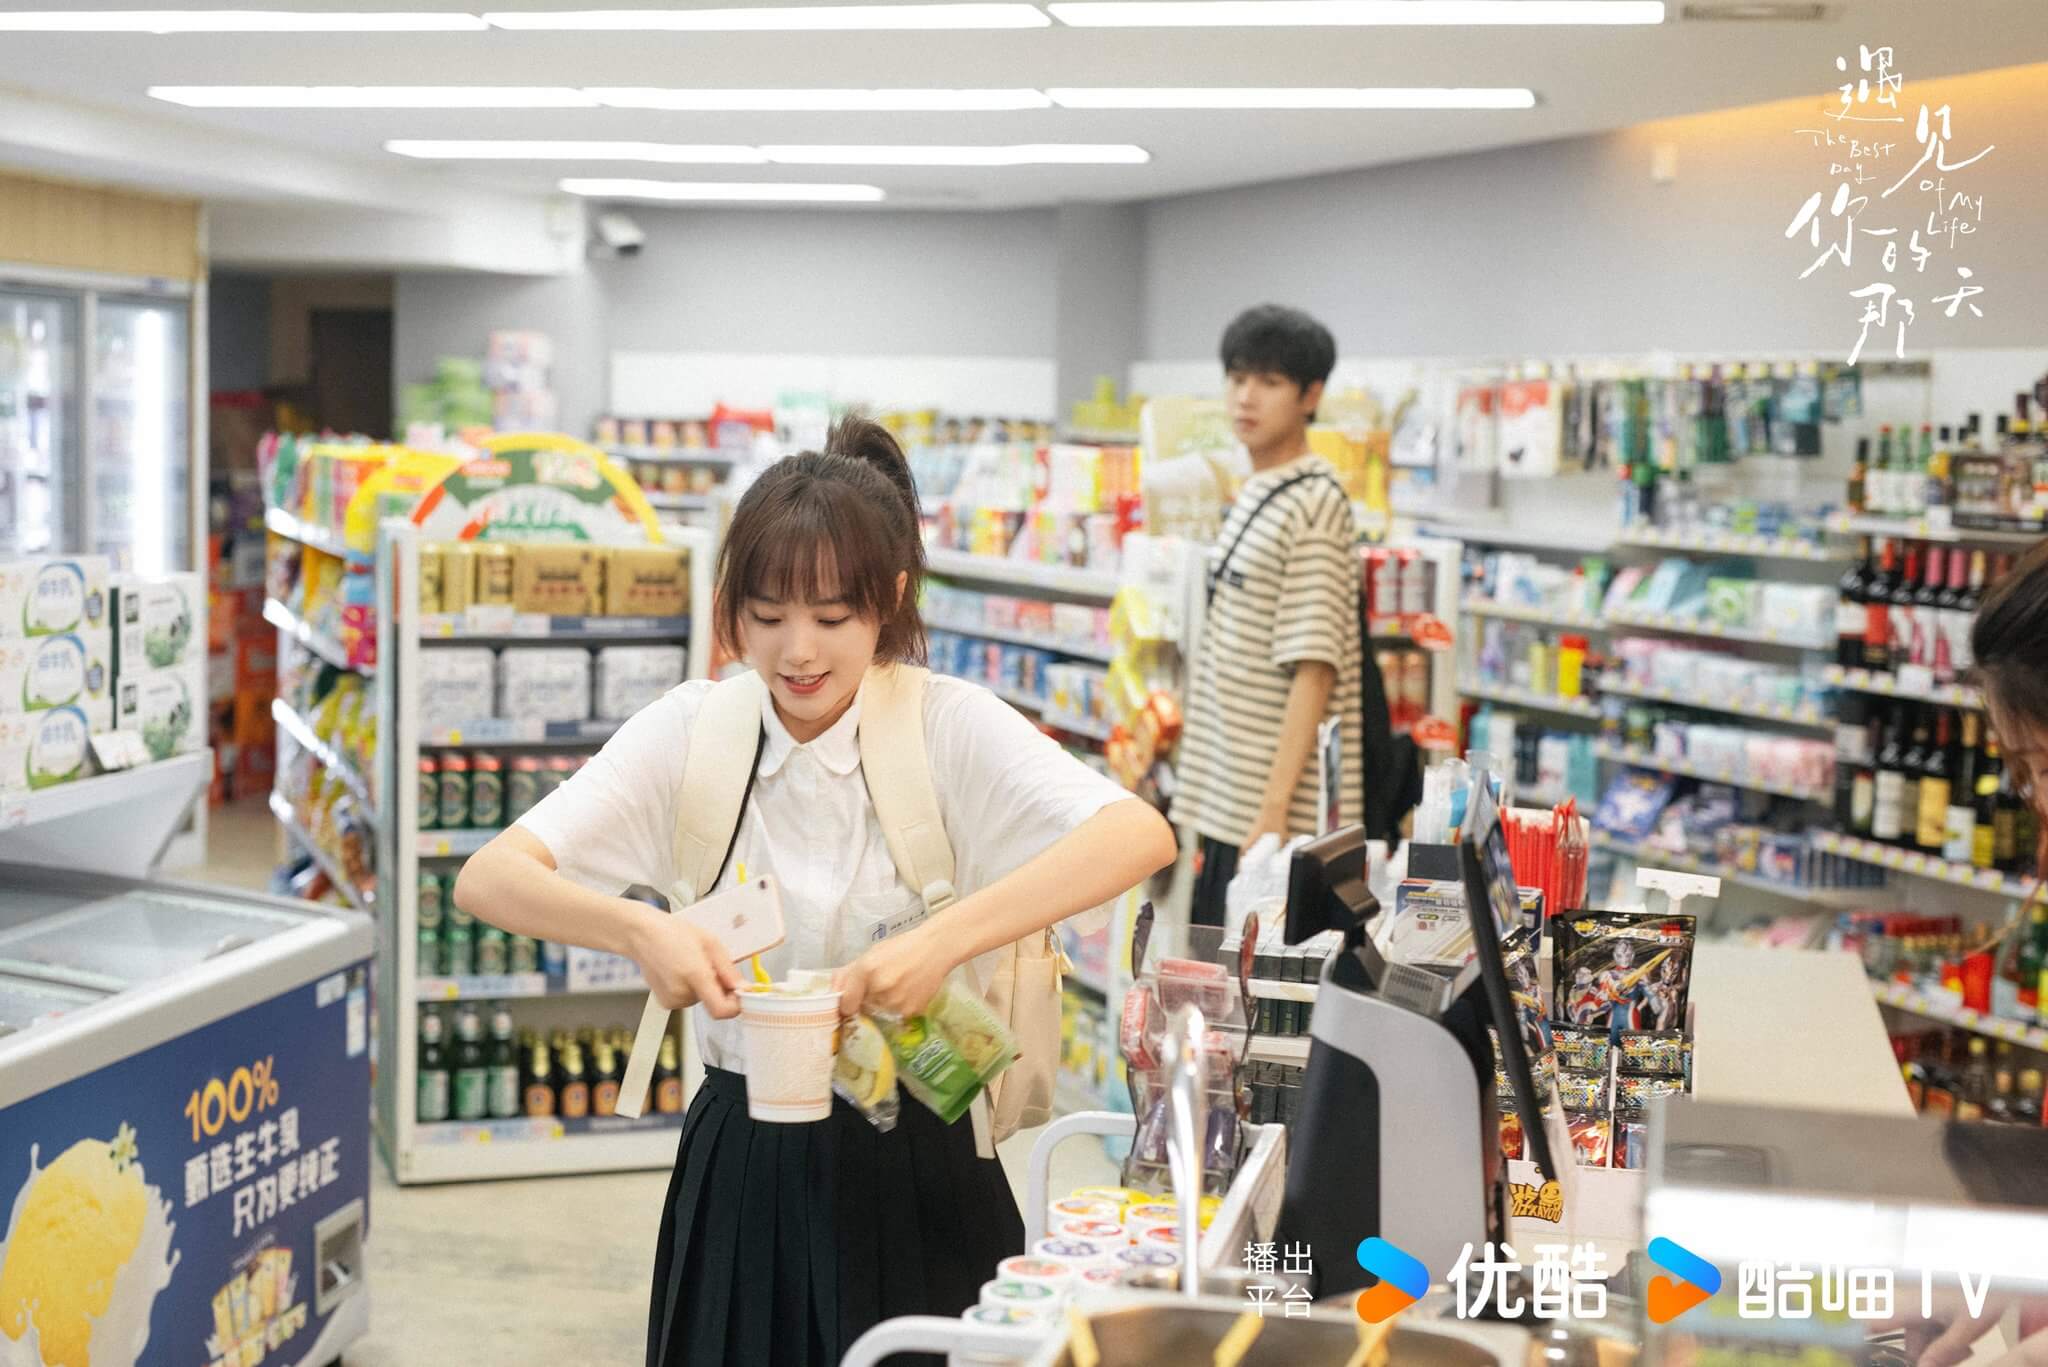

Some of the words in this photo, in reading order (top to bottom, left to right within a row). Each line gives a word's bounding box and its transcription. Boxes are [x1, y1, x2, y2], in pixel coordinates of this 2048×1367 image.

[185, 1055, 280, 1143] 100%
[184, 1106, 300, 1208] 甄选生牛乳
[233, 1136, 341, 1238] 只为更纯正
